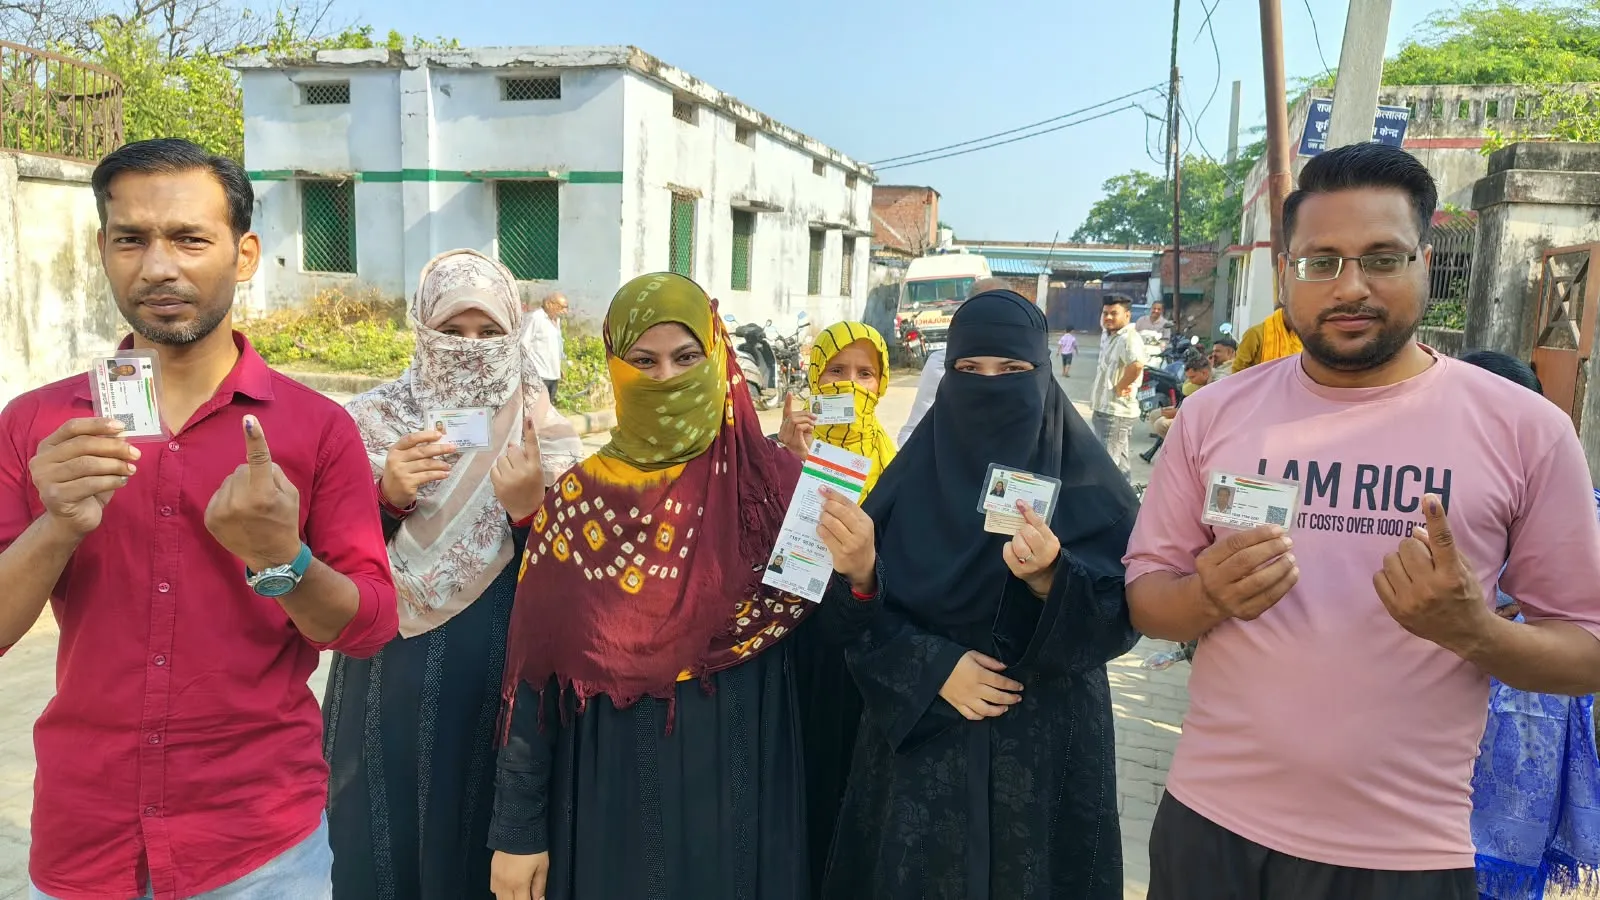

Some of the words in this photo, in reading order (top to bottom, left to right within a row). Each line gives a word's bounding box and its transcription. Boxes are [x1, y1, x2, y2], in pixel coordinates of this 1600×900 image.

[1352, 463, 1452, 517] RICH
[1309, 513, 1345, 532] COSTS
[1348, 516, 1374, 534] OVER
[1376, 517, 1403, 537] 1000
